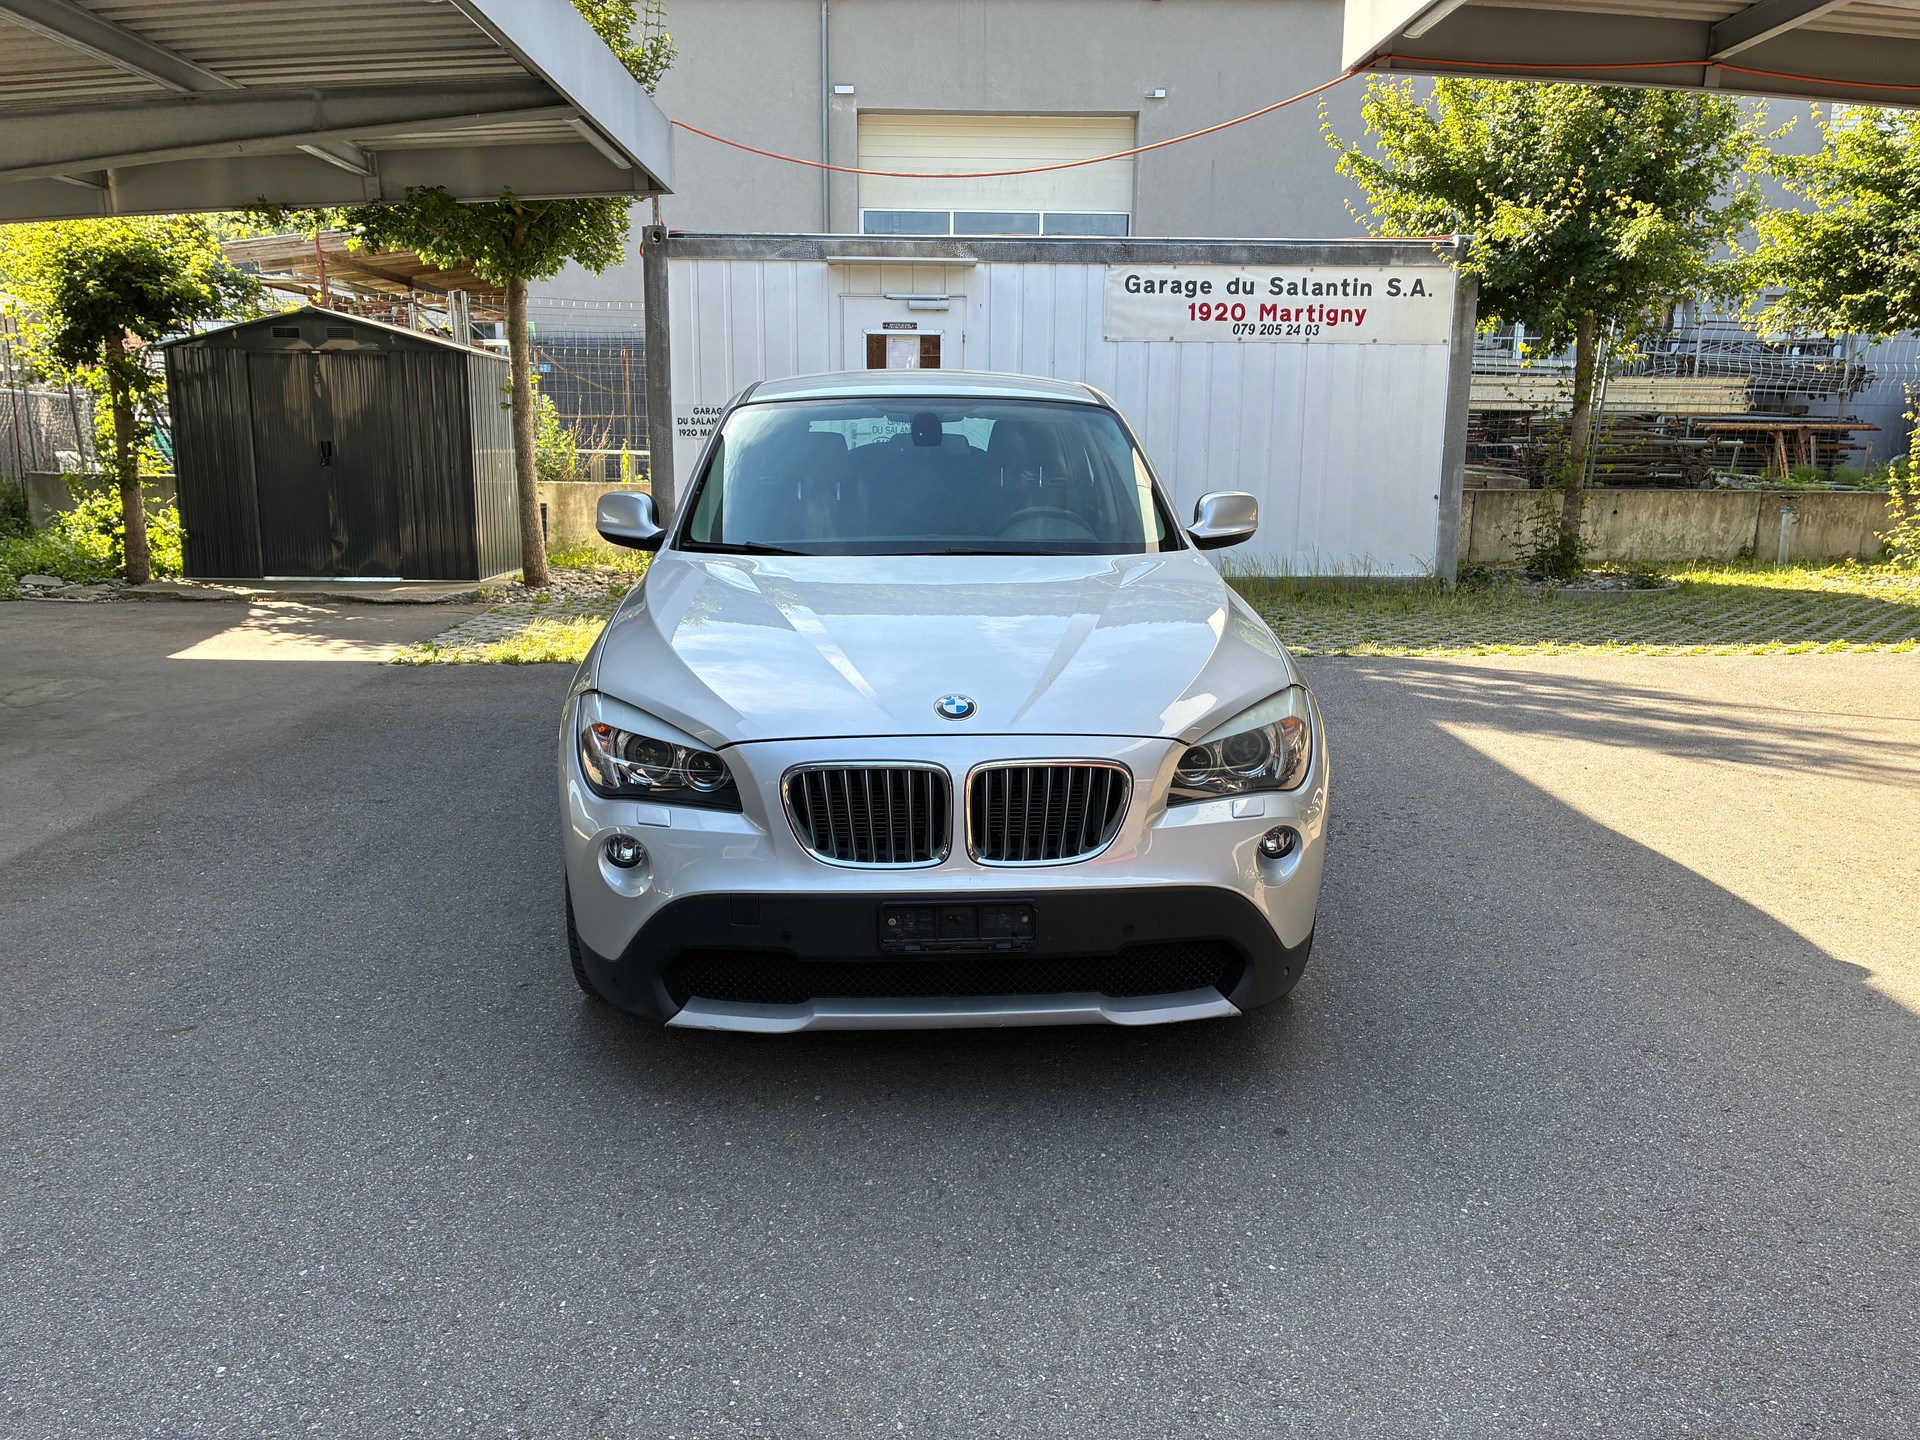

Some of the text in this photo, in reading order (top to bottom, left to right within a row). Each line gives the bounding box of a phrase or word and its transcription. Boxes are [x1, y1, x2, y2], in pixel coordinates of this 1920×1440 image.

[1125, 275, 1433, 298] Garage du Salantin S.A.
[1188, 303, 1367, 327] 1920 Martigny
[1232, 324, 1320, 336] 079 205 24 03
[872, 426, 882, 434] DU
